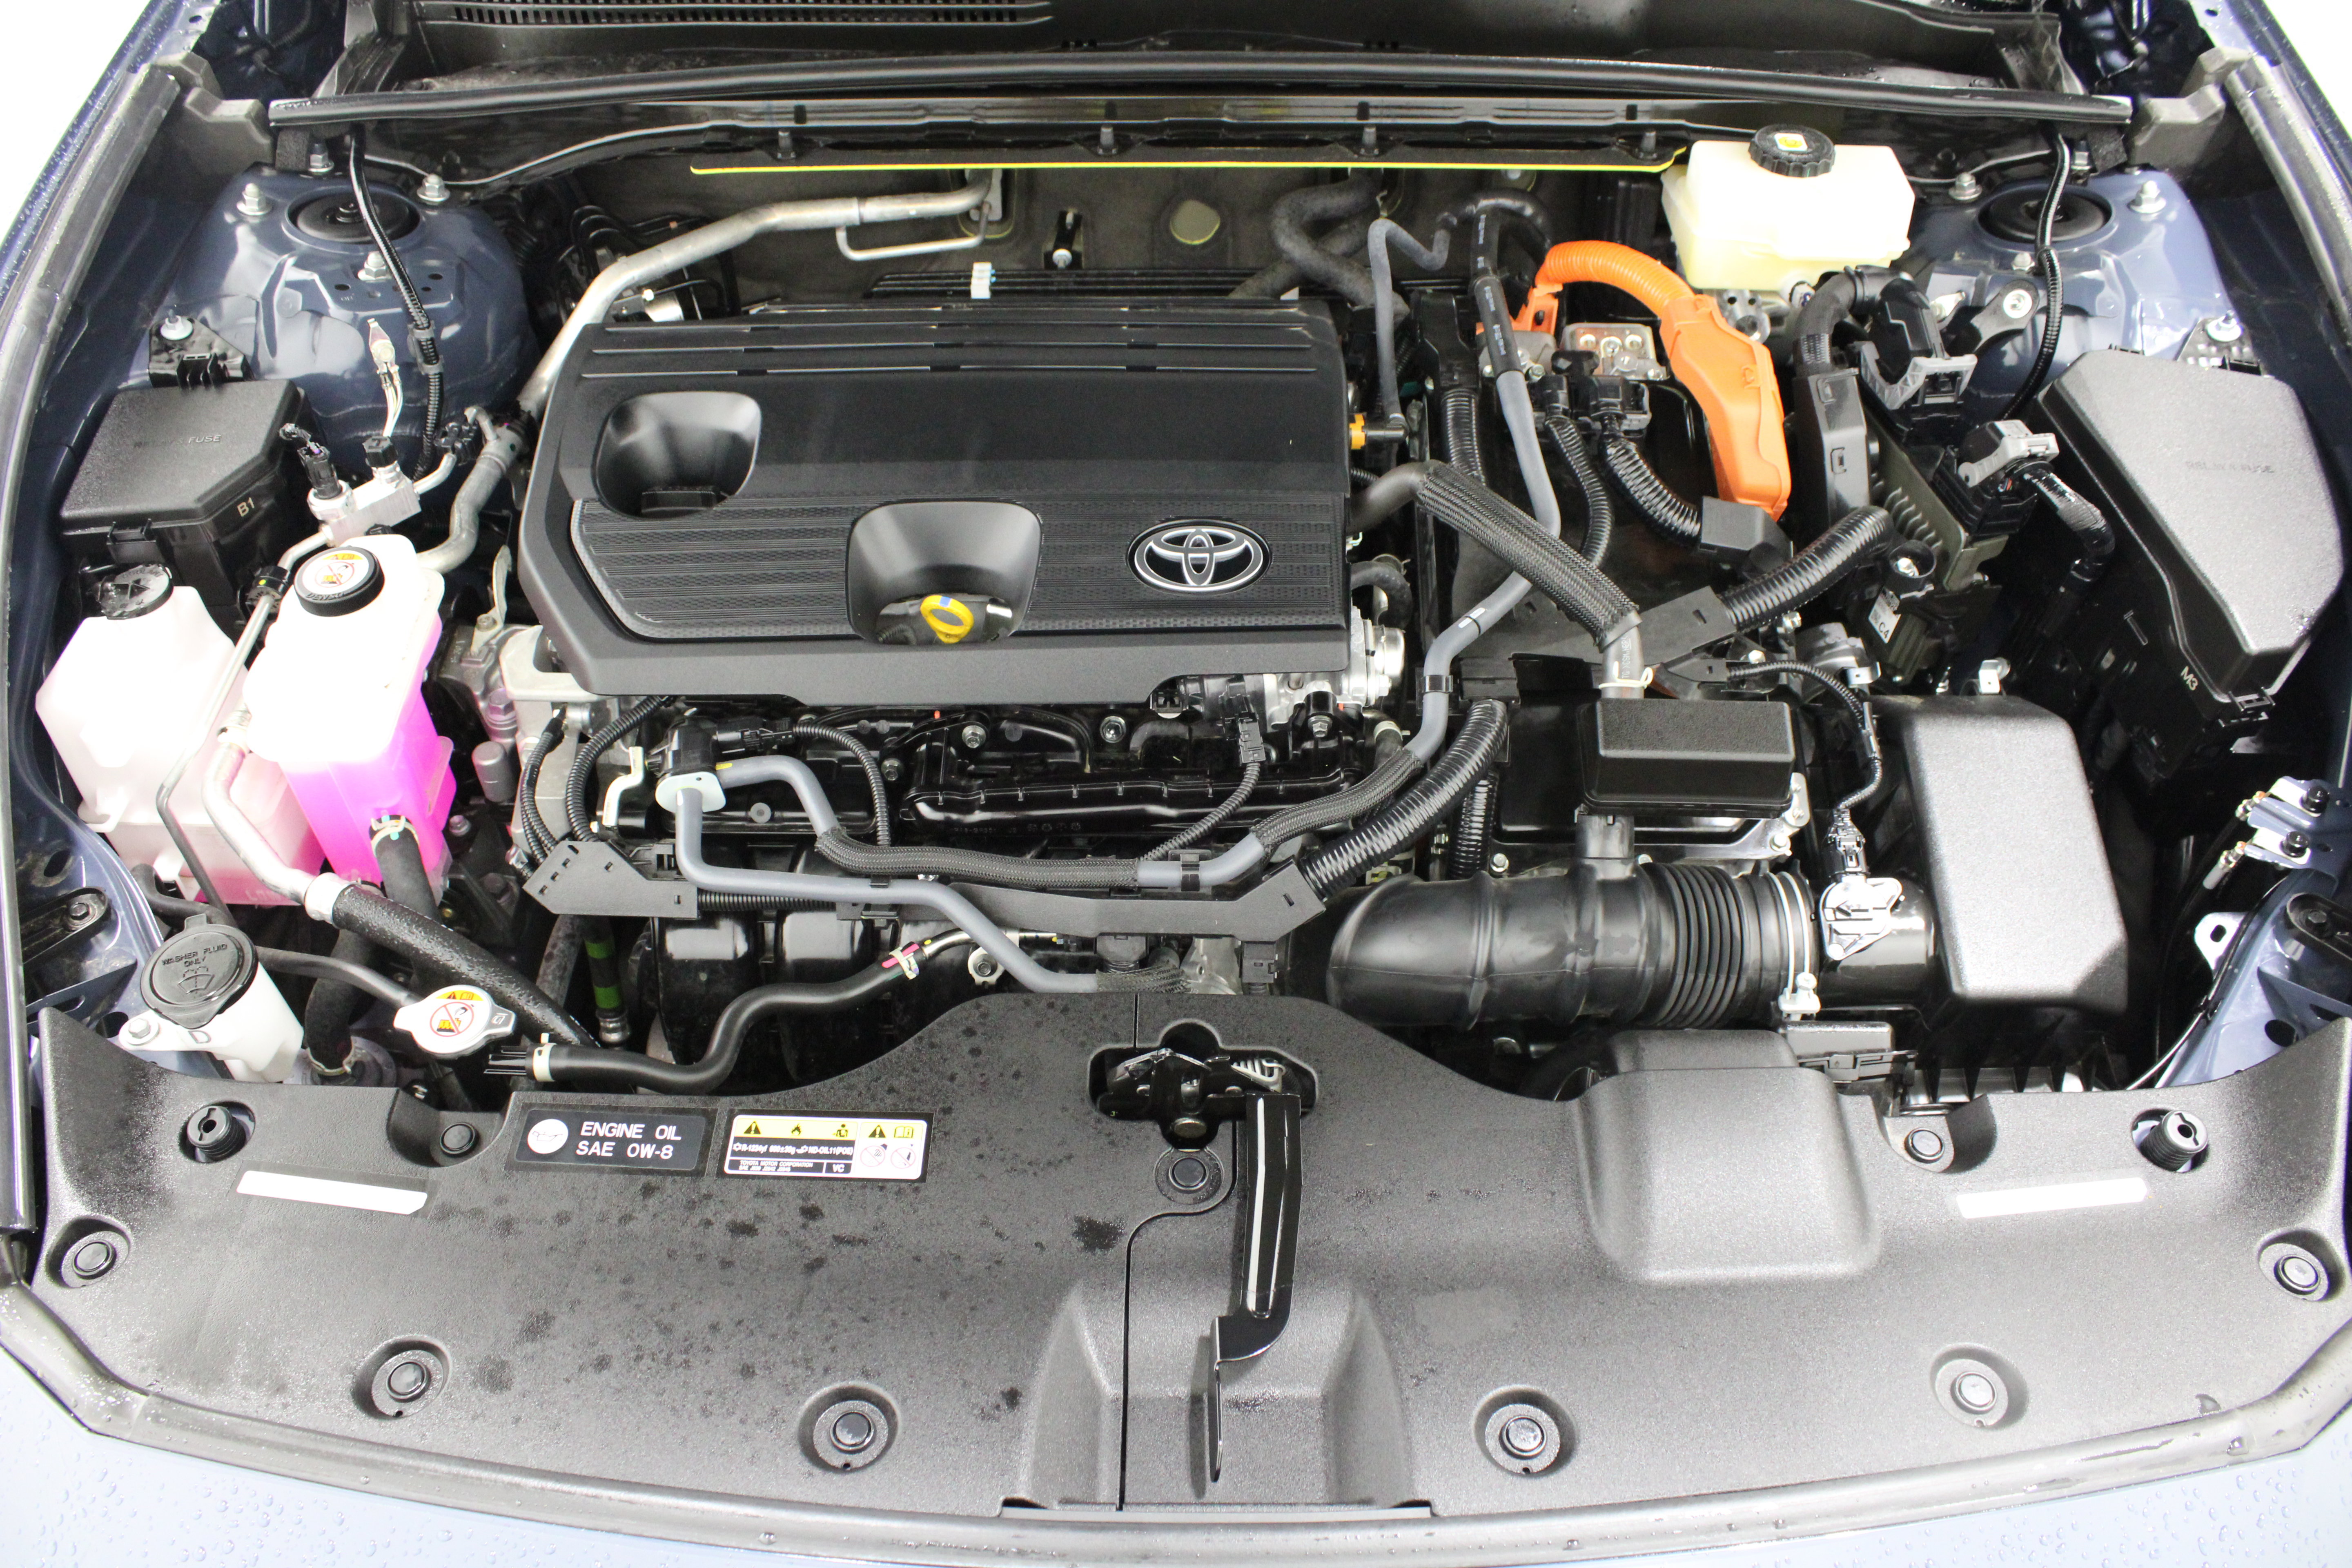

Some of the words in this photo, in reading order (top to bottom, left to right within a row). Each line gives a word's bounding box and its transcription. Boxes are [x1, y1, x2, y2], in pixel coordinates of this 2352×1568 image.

[188, 434, 222, 443] FUSE
[237, 497, 255, 517] B1
[2180, 666, 2198, 691] M3
[162, 951, 198, 966] WASHER
[203, 944, 228, 955] FLUID
[184, 956, 206, 967] ONLY
[580, 1121, 645, 1139] ENGINE
[655, 1125, 682, 1140] OIL
[575, 1140, 616, 1157] SAE
[626, 1143, 674, 1160] 0W-8
[832, 1164, 845, 1173] VC
